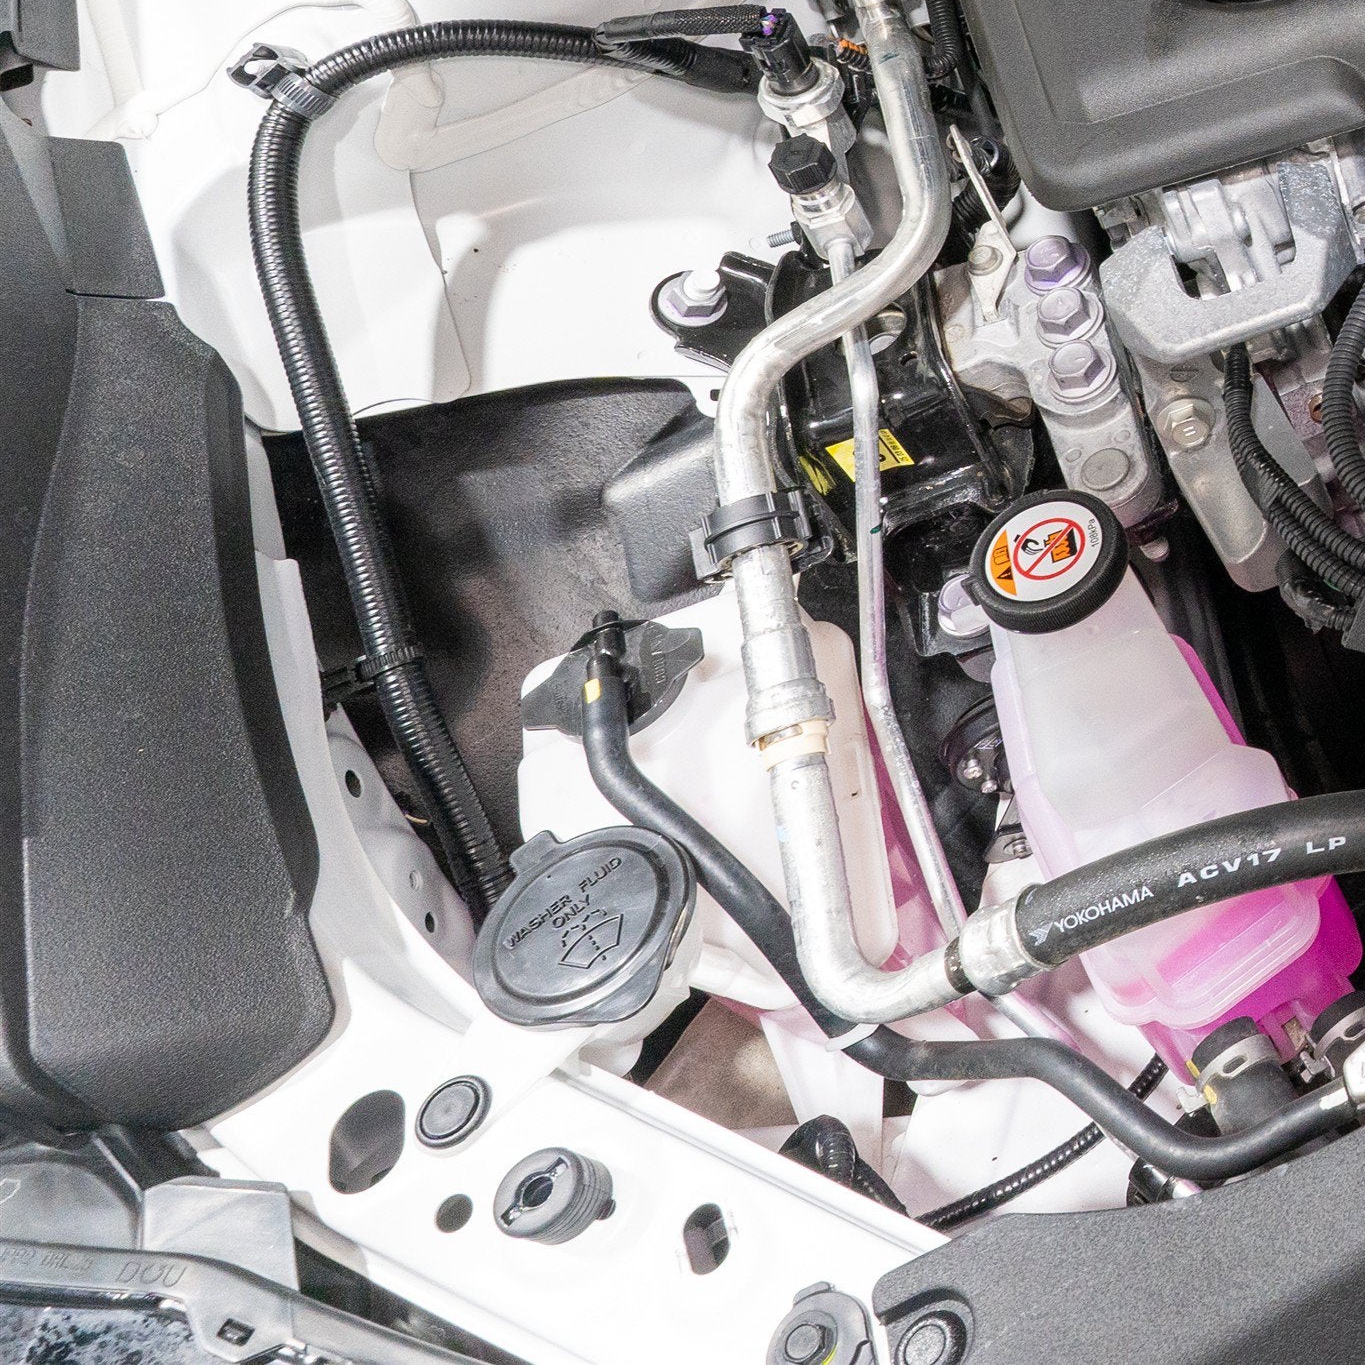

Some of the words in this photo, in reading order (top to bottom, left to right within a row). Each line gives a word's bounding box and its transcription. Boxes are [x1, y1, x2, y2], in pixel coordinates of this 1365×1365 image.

[1088, 518, 1100, 547] 108kPa
[504, 894, 573, 950] WASHER
[579, 856, 623, 894] FLUID
[552, 894, 592, 929] ONLY
[1054, 884, 1154, 934] YOKOHAMA
[1177, 847, 1282, 888] ACV17
[1305, 835, 1348, 856] LP
